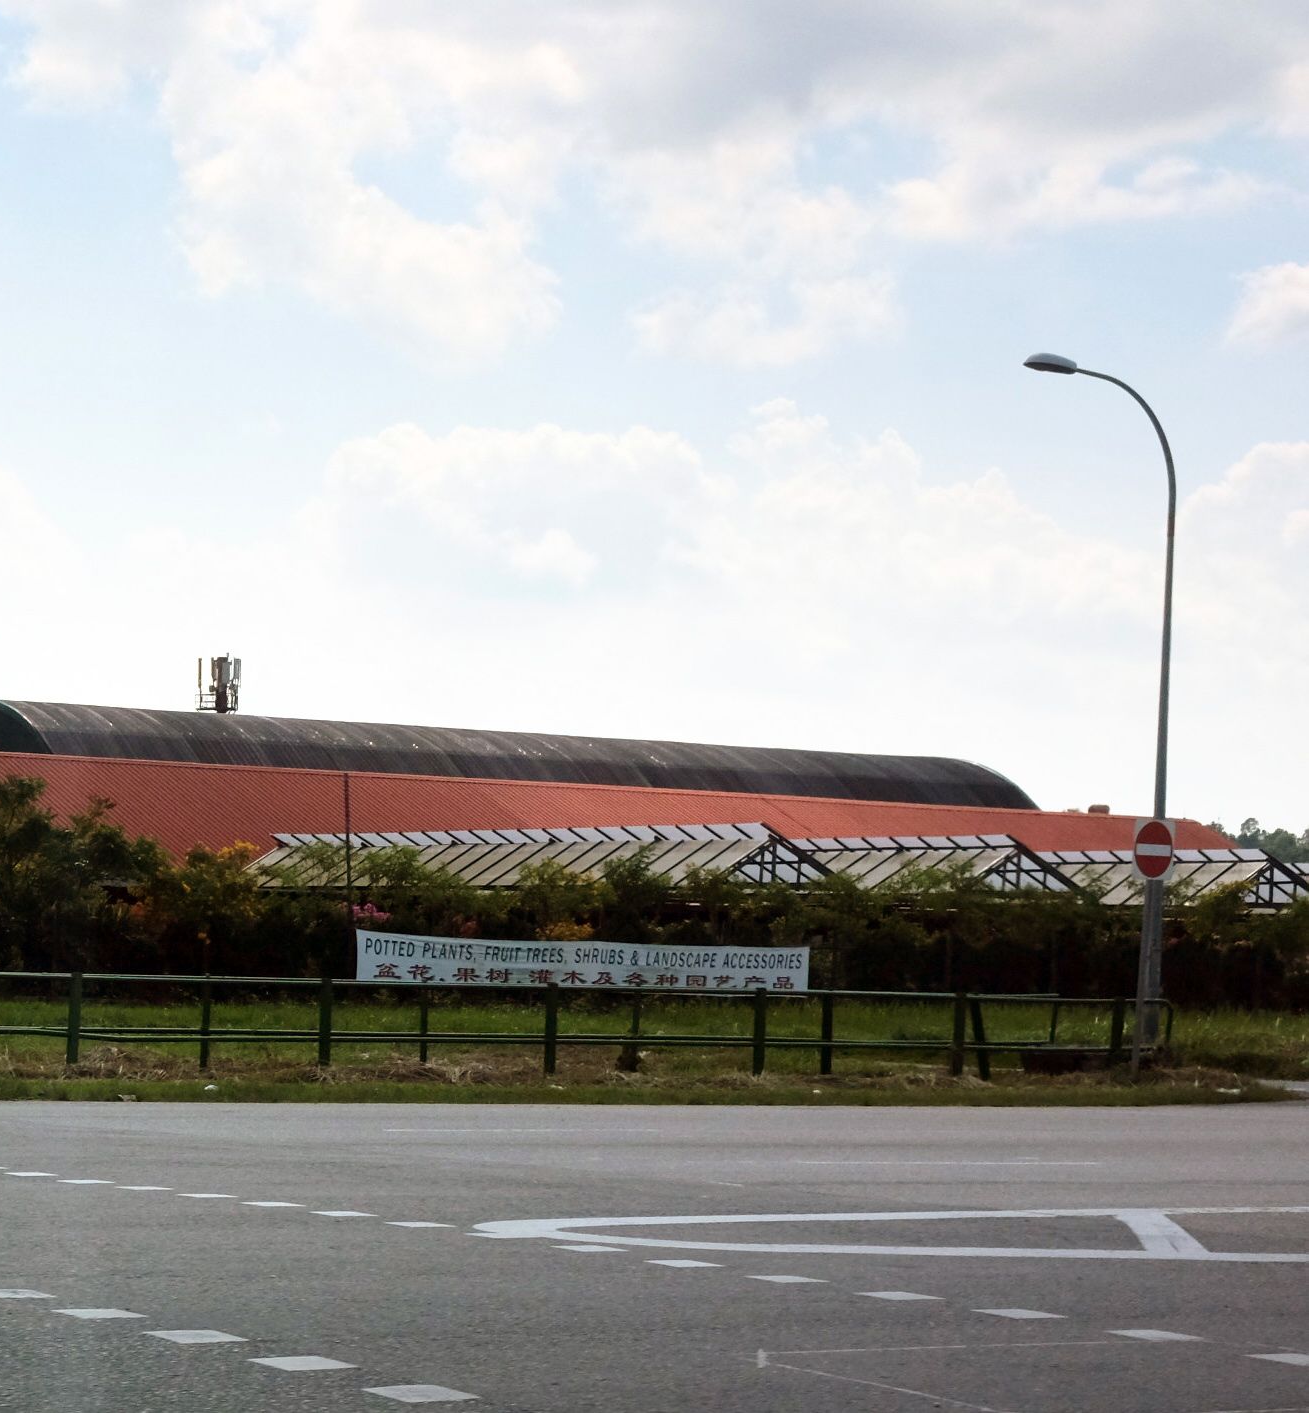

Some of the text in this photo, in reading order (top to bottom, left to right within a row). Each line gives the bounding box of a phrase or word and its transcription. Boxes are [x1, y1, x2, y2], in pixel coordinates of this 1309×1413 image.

[365, 938, 803, 970] POTTED PLANTS, FRUIT TREES, SHRUBS & LANDSCAPE ACCESSORIES
